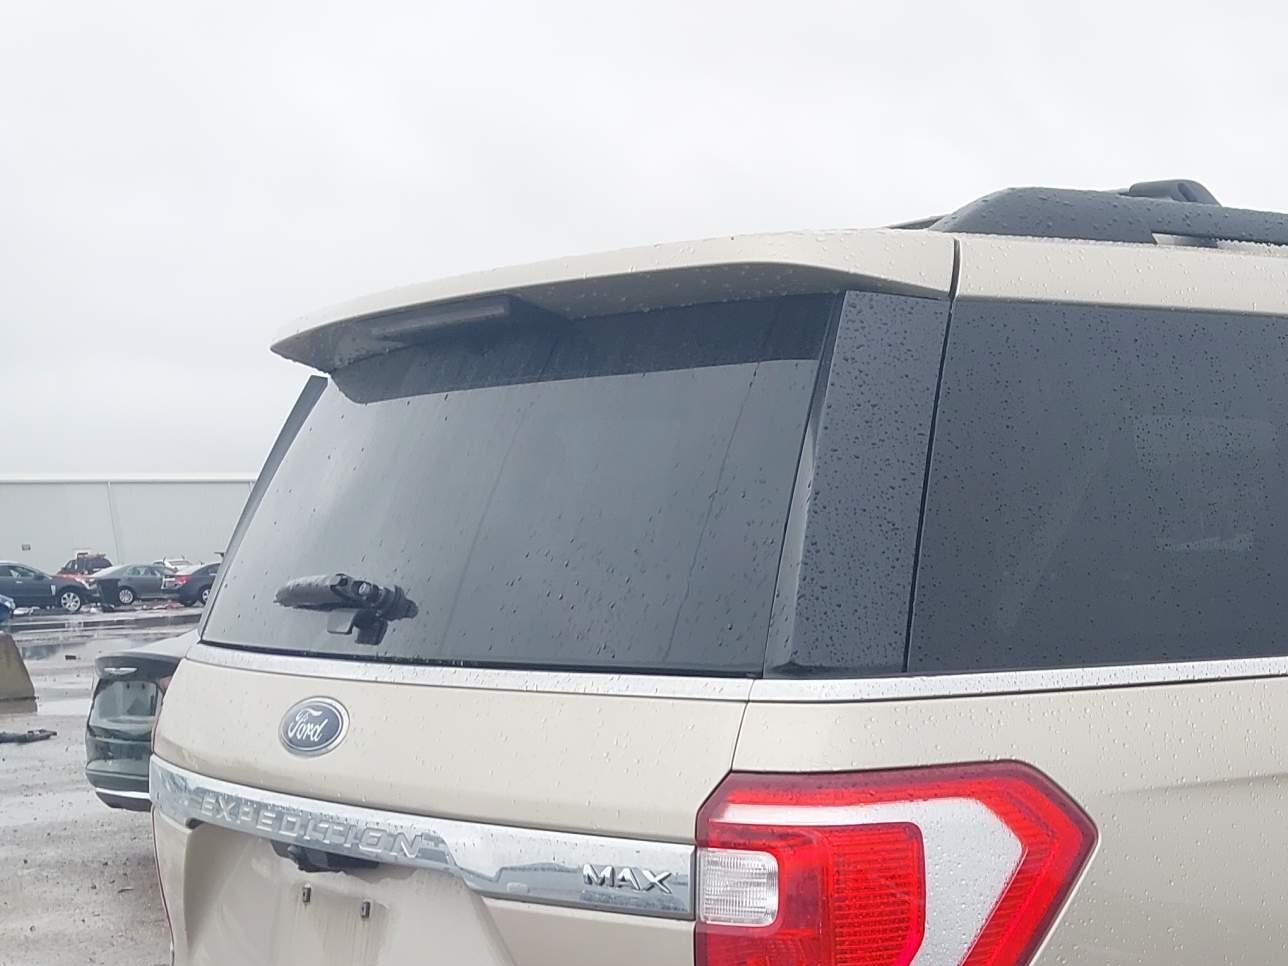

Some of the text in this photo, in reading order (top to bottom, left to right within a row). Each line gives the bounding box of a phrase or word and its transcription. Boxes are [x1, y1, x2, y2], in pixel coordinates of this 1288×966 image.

[287, 707, 329, 742] Ford
[199, 794, 424, 859] EXPEDITION
[582, 863, 673, 895] MAX
